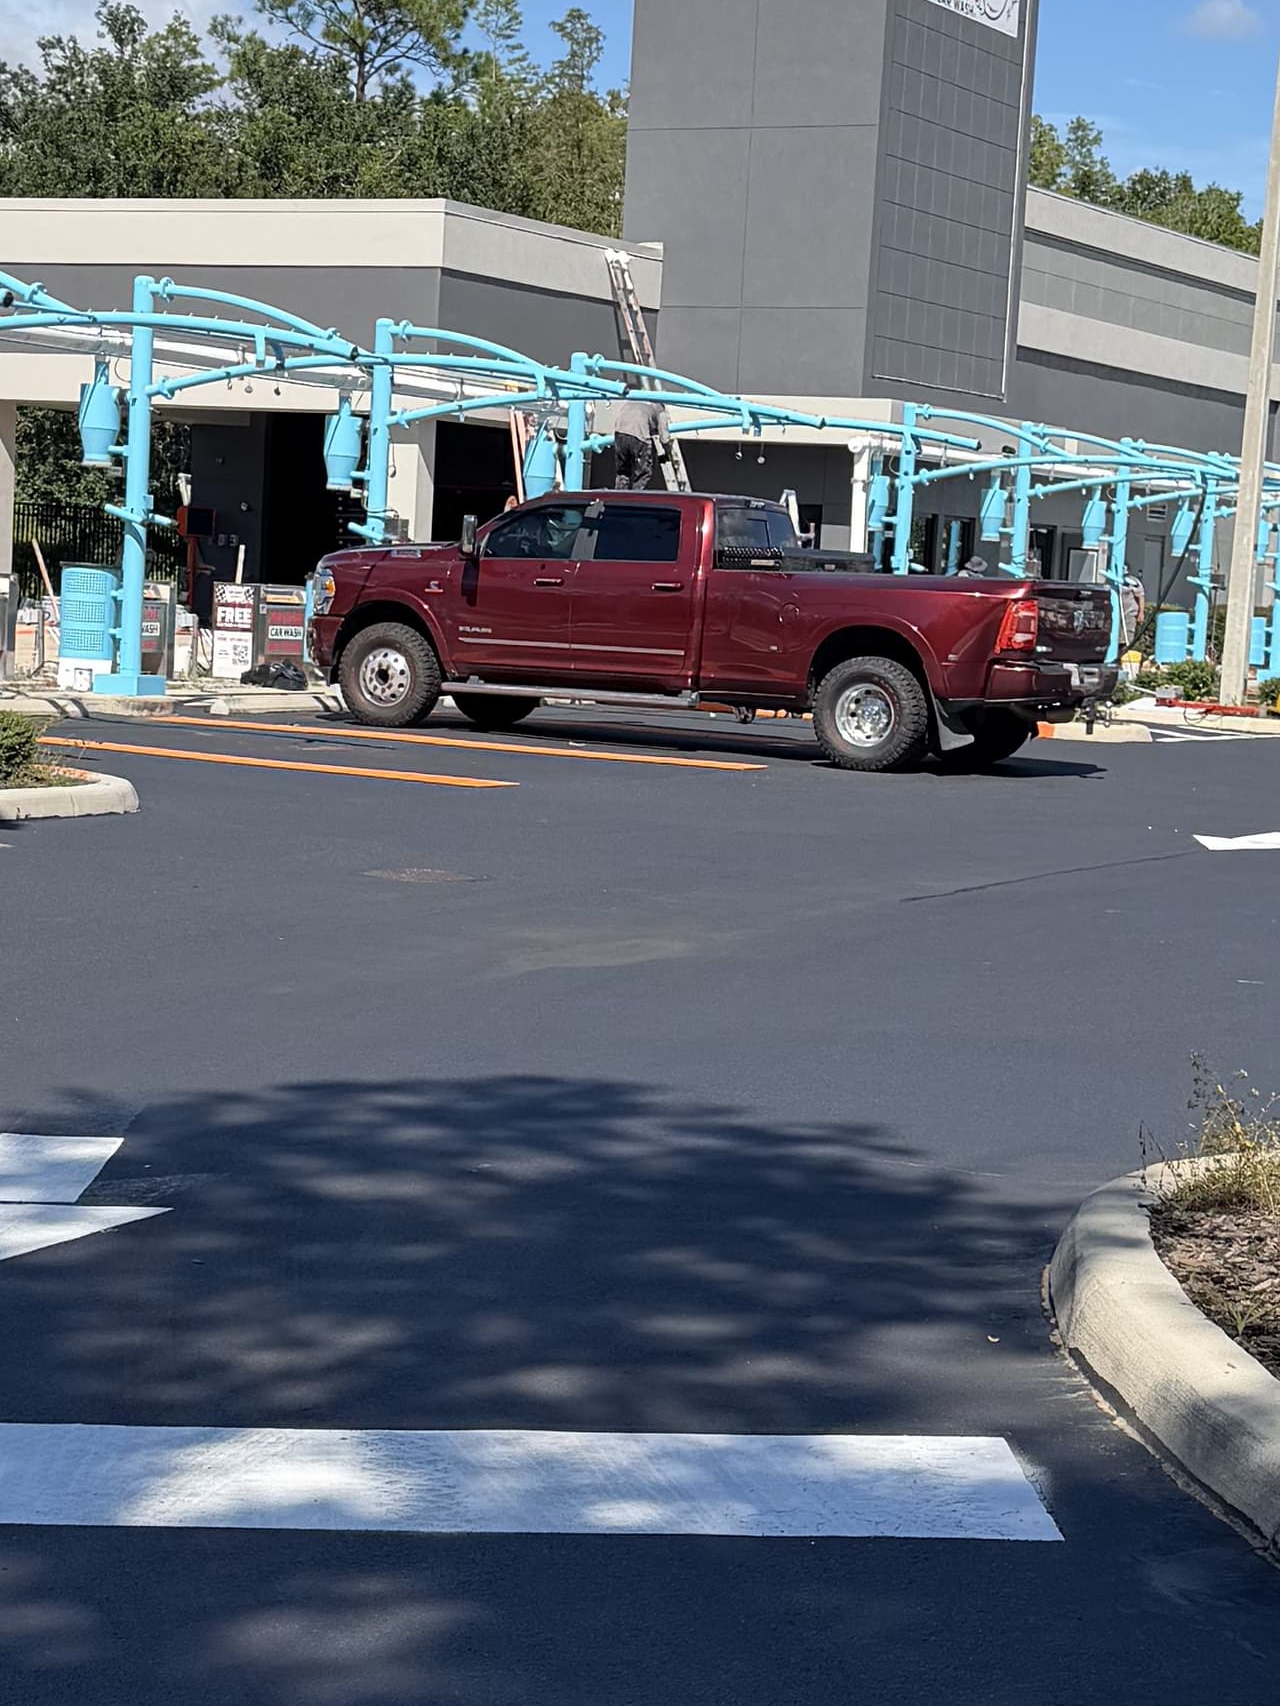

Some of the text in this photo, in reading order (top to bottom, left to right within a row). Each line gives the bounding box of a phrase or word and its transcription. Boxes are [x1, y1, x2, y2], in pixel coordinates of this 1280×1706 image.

[217, 607, 252, 624] FREE
[270, 627, 302, 638] CAR WASH
